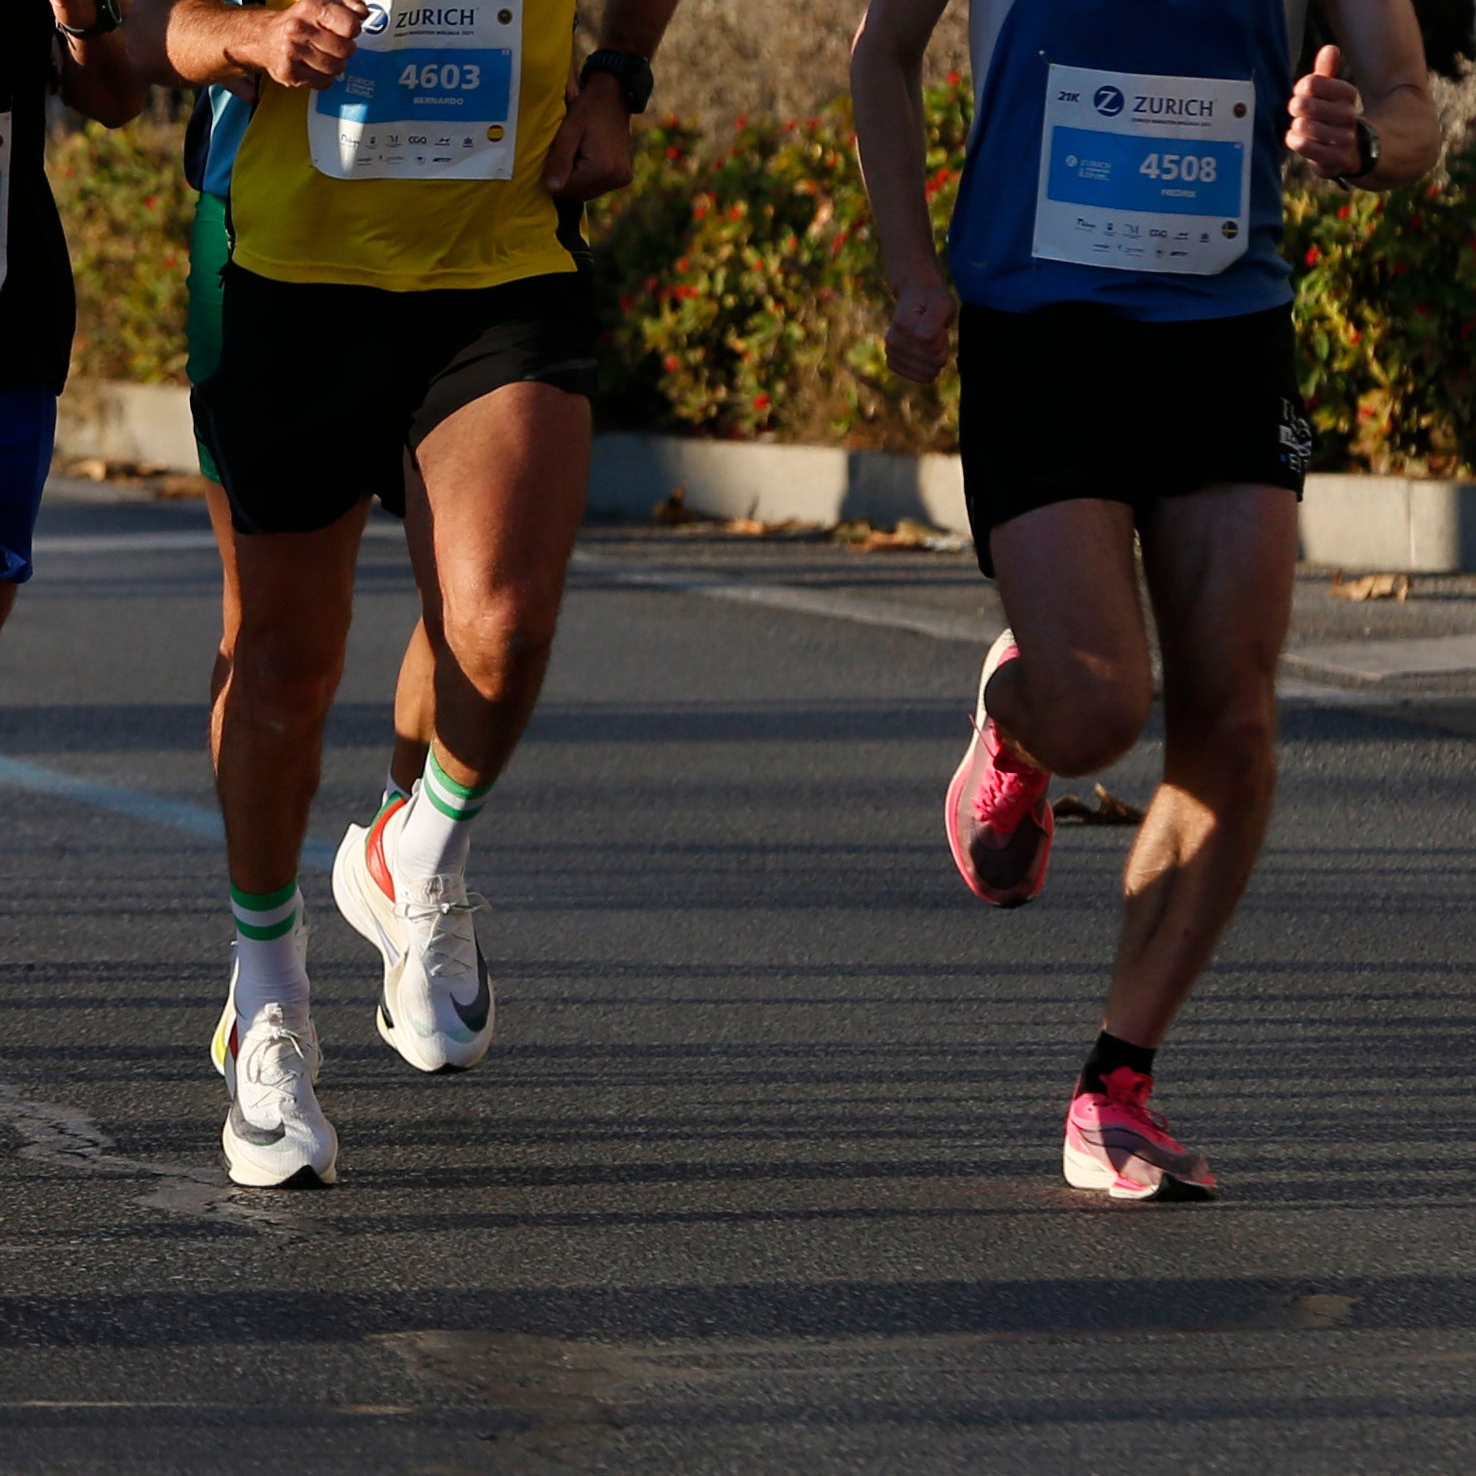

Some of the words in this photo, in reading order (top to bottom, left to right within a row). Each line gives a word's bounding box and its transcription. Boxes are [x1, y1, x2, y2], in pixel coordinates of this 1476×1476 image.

[395, 8, 475, 28] ZURICH
[399, 63, 481, 90] 4603
[1057, 91, 1080, 103] 21K
[1133, 96, 1213, 117] ZURICH
[1139, 153, 1217, 183] 4508
